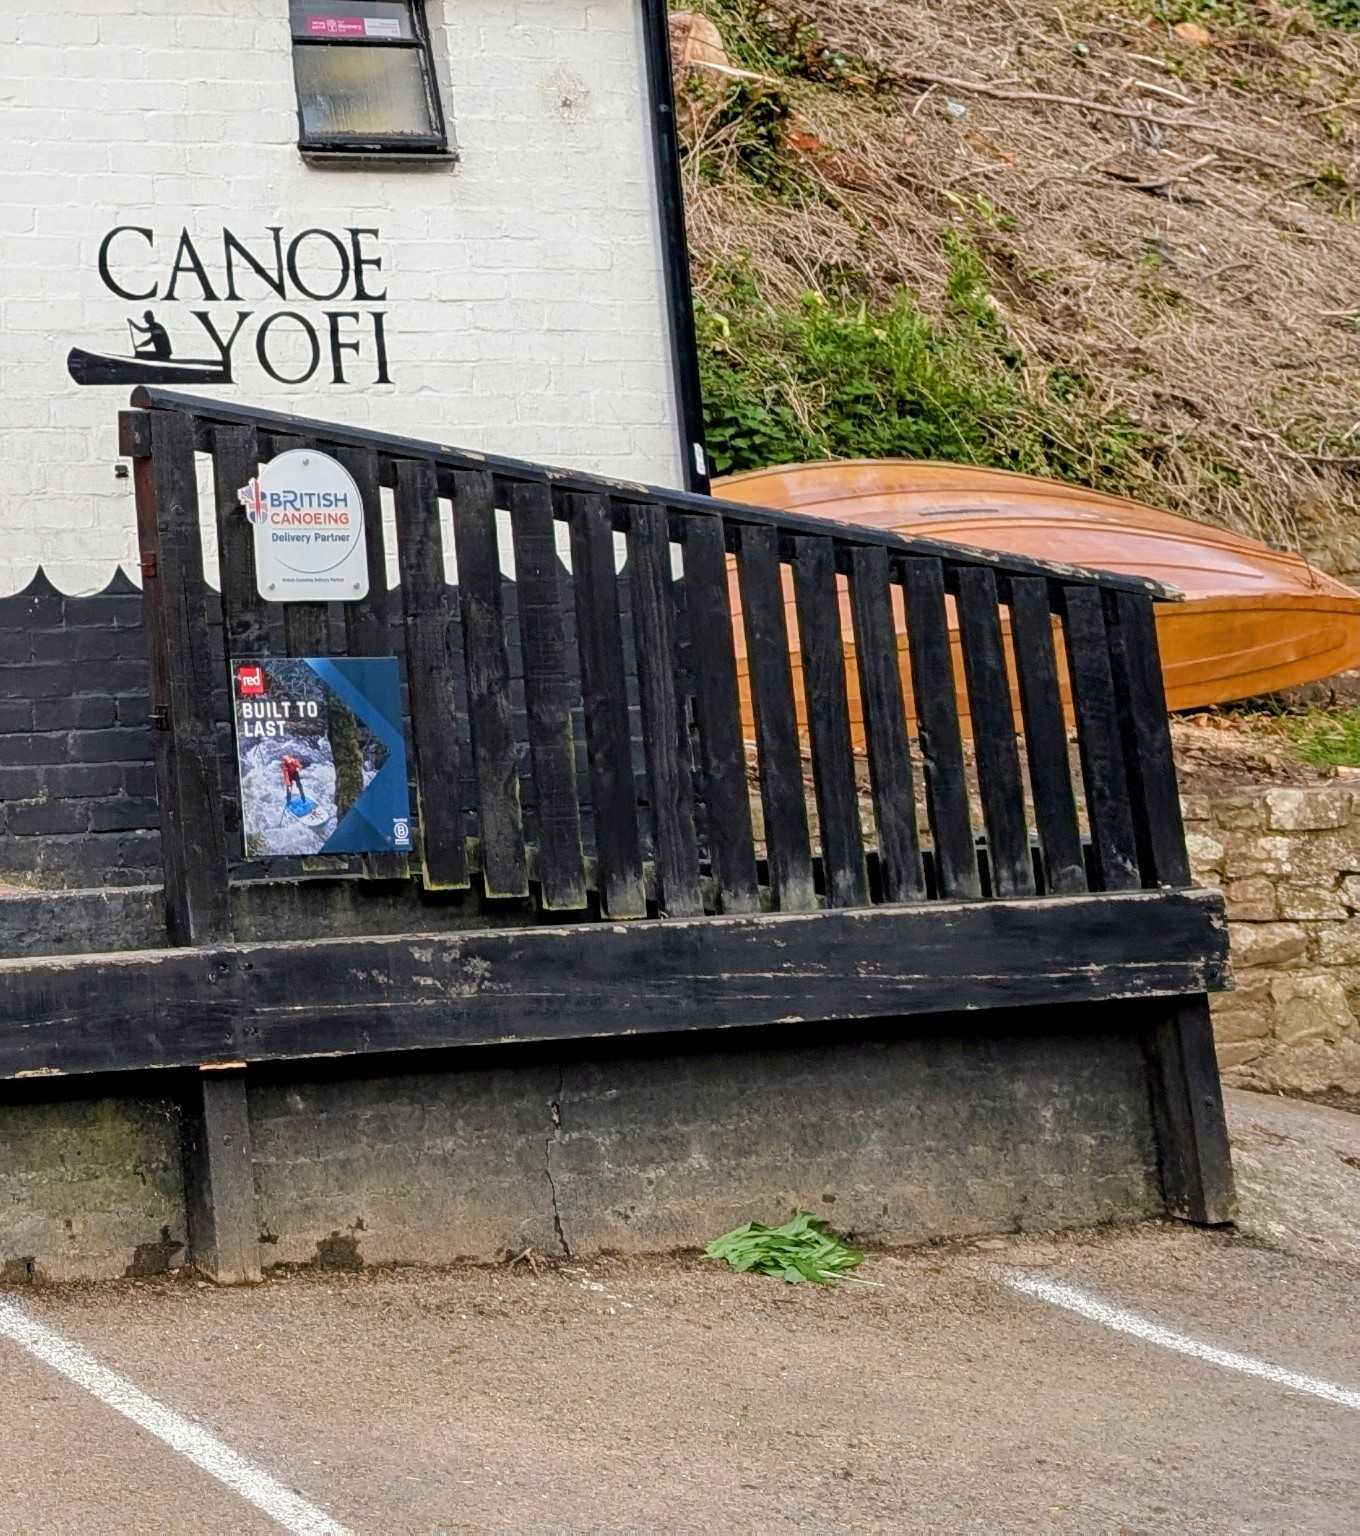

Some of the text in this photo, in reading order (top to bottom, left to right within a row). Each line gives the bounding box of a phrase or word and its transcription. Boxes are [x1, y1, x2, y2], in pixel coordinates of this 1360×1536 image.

[98, 225, 388, 302] CANOE
[189, 310, 396, 384] YOFI
[270, 490, 348, 512] BRITISH
[270, 512, 349, 525] CANOEING
[271, 532, 351, 544] Delivery Partner
[242, 667, 261, 687] red
[241, 701, 318, 719] BUILT TO
[244, 720, 286, 737] LAST
